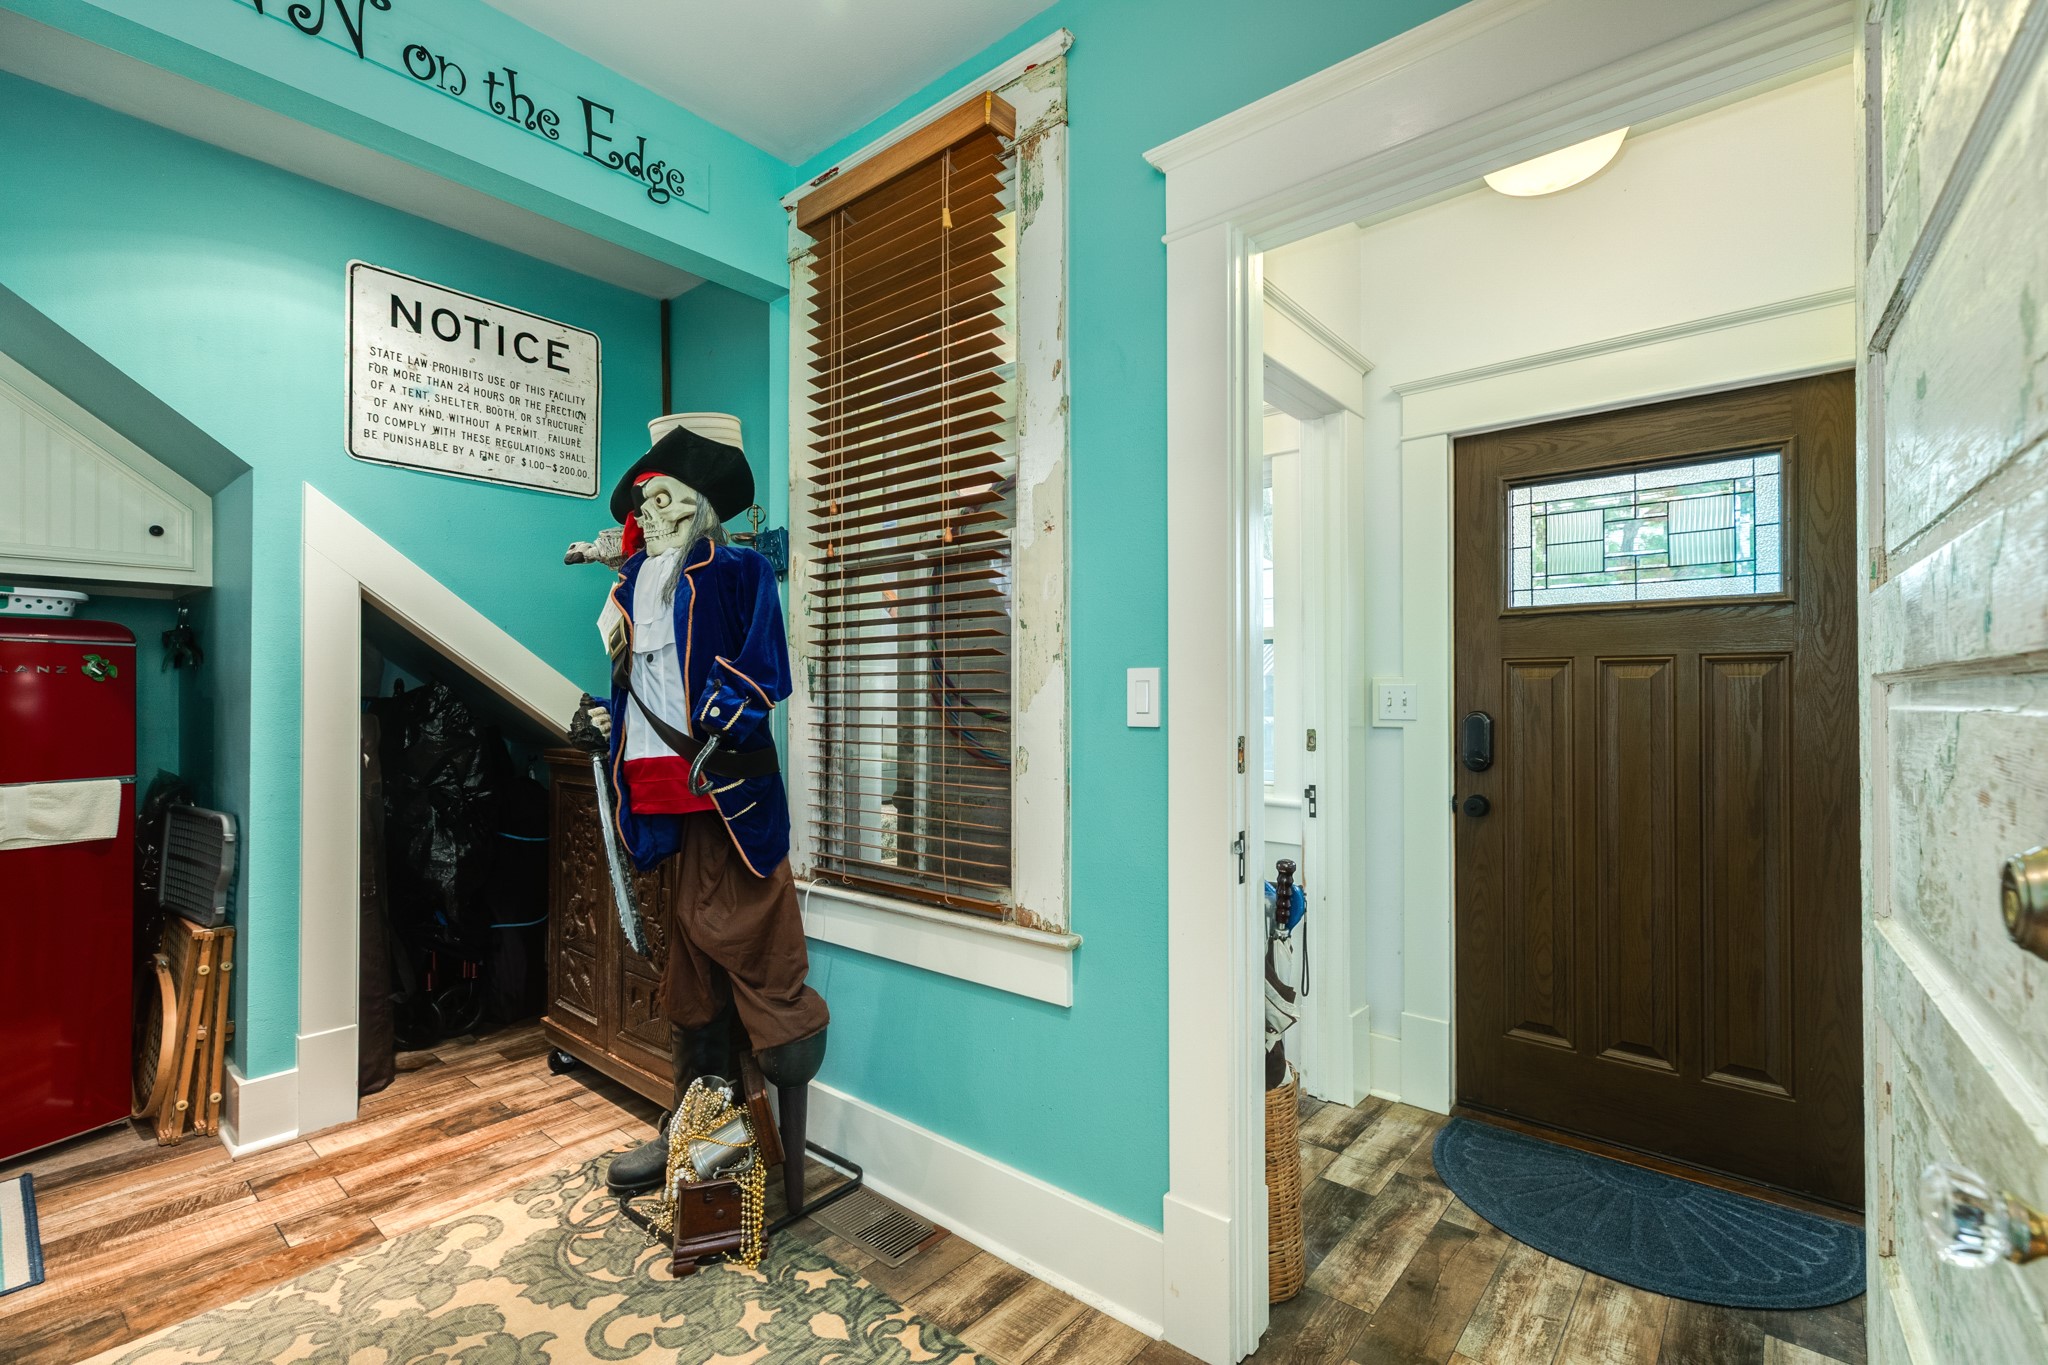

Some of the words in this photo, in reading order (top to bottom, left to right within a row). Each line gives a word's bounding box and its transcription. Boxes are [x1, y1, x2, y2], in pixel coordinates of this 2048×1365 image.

[403, 43, 466, 96] on
[483, 67, 560, 141] the
[577, 96, 685, 204] Edge
[390, 294, 570, 374] NOTICE
[368, 363, 388, 375] FOR
[394, 368, 422, 383] MORE
[427, 376, 453, 390] THAN
[458, 384, 470, 394] 24
[474, 387, 504, 402] HOURS
[509, 396, 520, 406] OR
[525, 399, 541, 410] THE
[546, 404, 586, 420] ERECTION
[370, 346, 402, 362] STATE
[408, 356, 428, 368] LAW
[432, 362, 484, 381] PROHIBITS
[488, 375, 506, 387] USE
[510, 380, 520, 390] OF
[526, 384, 545, 396] THIS
[549, 390, 585, 406] FACILITY
[370, 380, 384, 390] OF
[390, 384, 396, 393] A
[521, 413, 531, 422] OR
[536, 417, 584, 434] STRUCTURE
[374, 398, 387, 408] OF
[393, 402, 413, 413] ANY
[449, 413, 490, 429] WITHOUT
[495, 423, 500, 431] A
[548, 434, 581, 448] FAILURE
[364, 429, 377, 439] BE
[383, 432, 448, 452] PUNISHABLE
[453, 447, 464, 455] BY
[469, 449, 475, 457] A
[480, 451, 499, 462] FINE
[505, 455, 515, 464] OF
[367, 412, 379, 423] TO
[385, 416, 426, 432] COMPLY
[433, 426, 456, 438] WITH
[462, 431, 490, 445] THESE
[496, 438, 555, 457] REGULATIONS
[560, 451, 586, 463] SHALL
